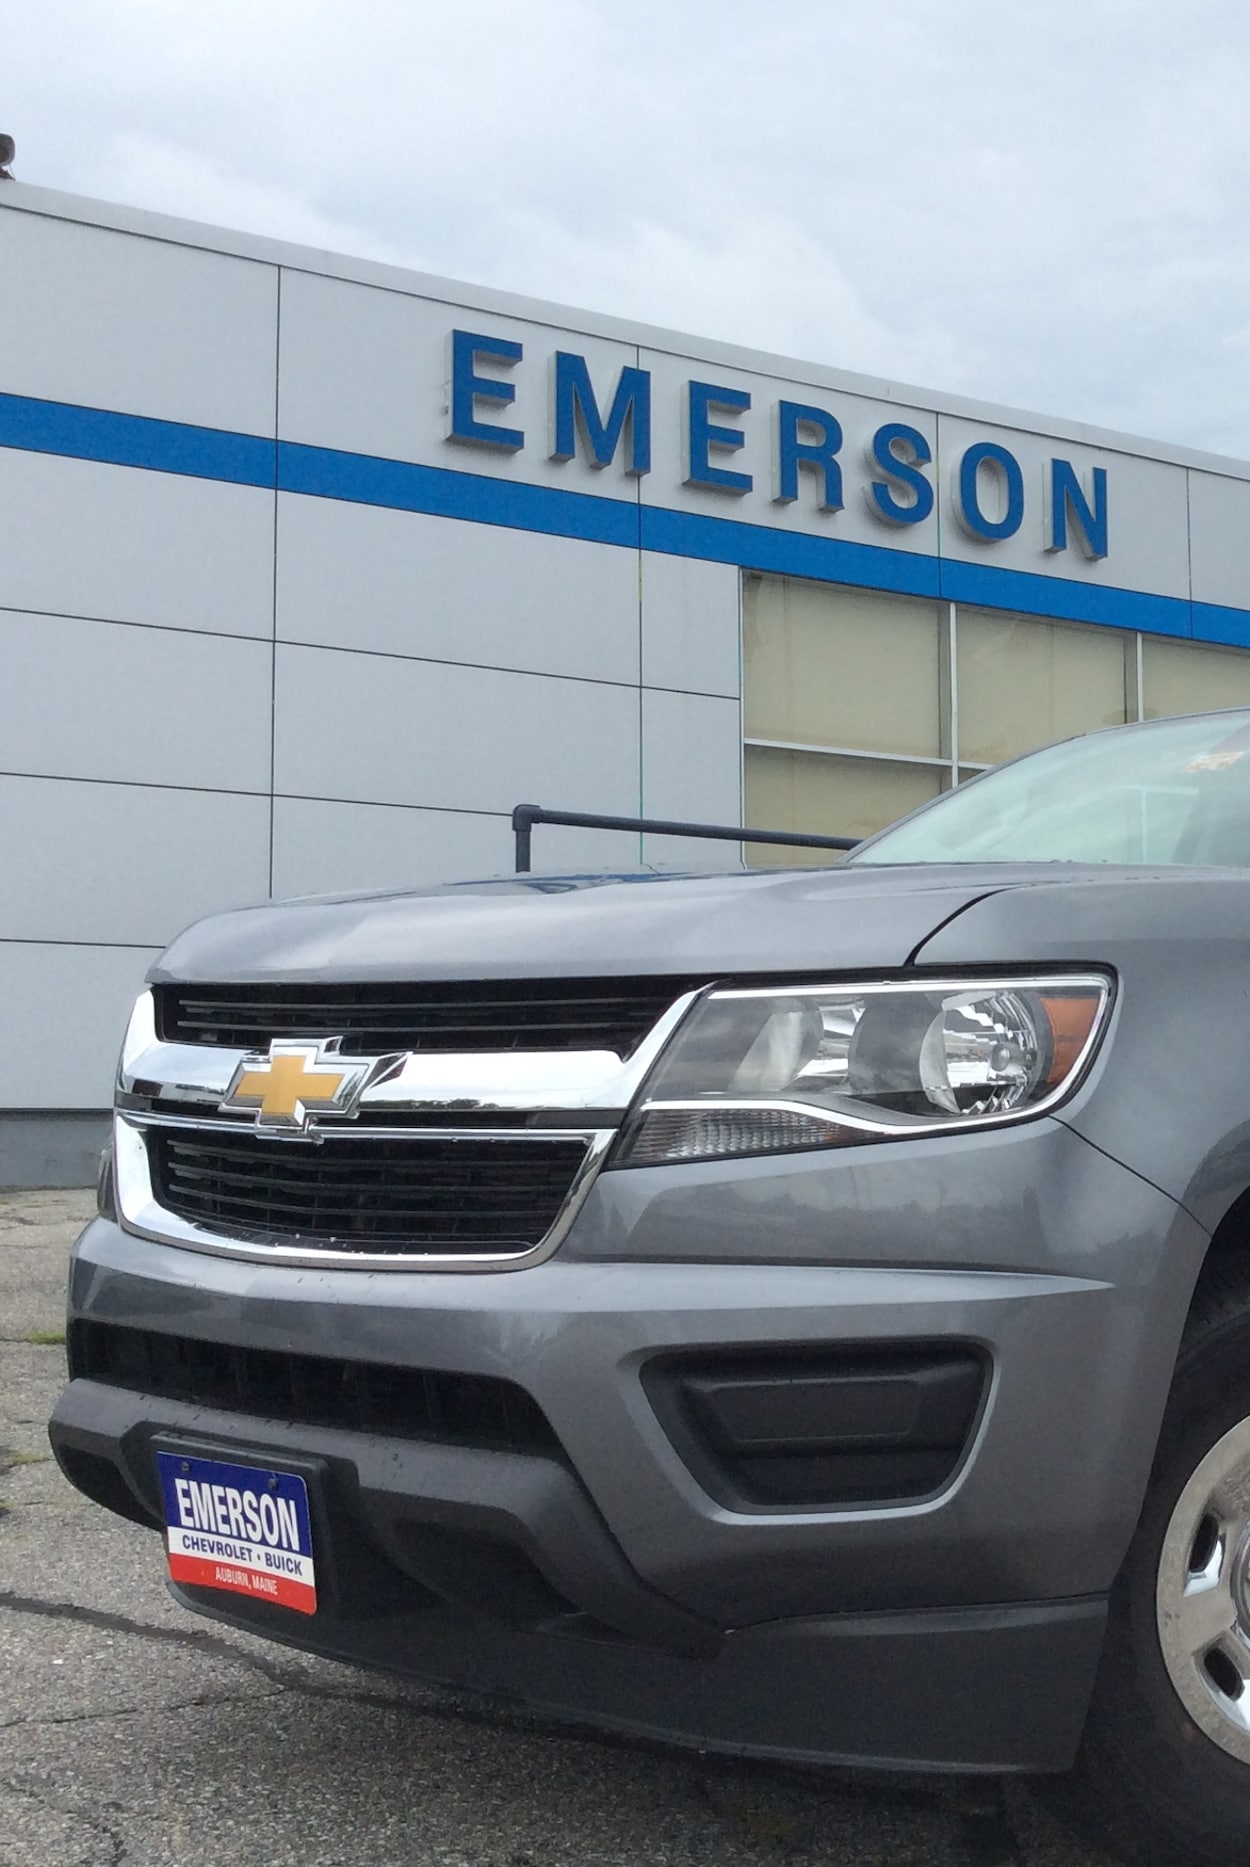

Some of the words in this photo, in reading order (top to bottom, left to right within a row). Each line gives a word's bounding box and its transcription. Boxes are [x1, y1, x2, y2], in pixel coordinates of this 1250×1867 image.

[449, 329, 1108, 562] EMERSON
[175, 1478, 300, 1551] EMERSON
[182, 1534, 253, 1562] CHEVROLET
[265, 1552, 303, 1576] BUICK
[215, 1566, 252, 1589] AUBURN,
[252, 1574, 278, 1596] MAINE
